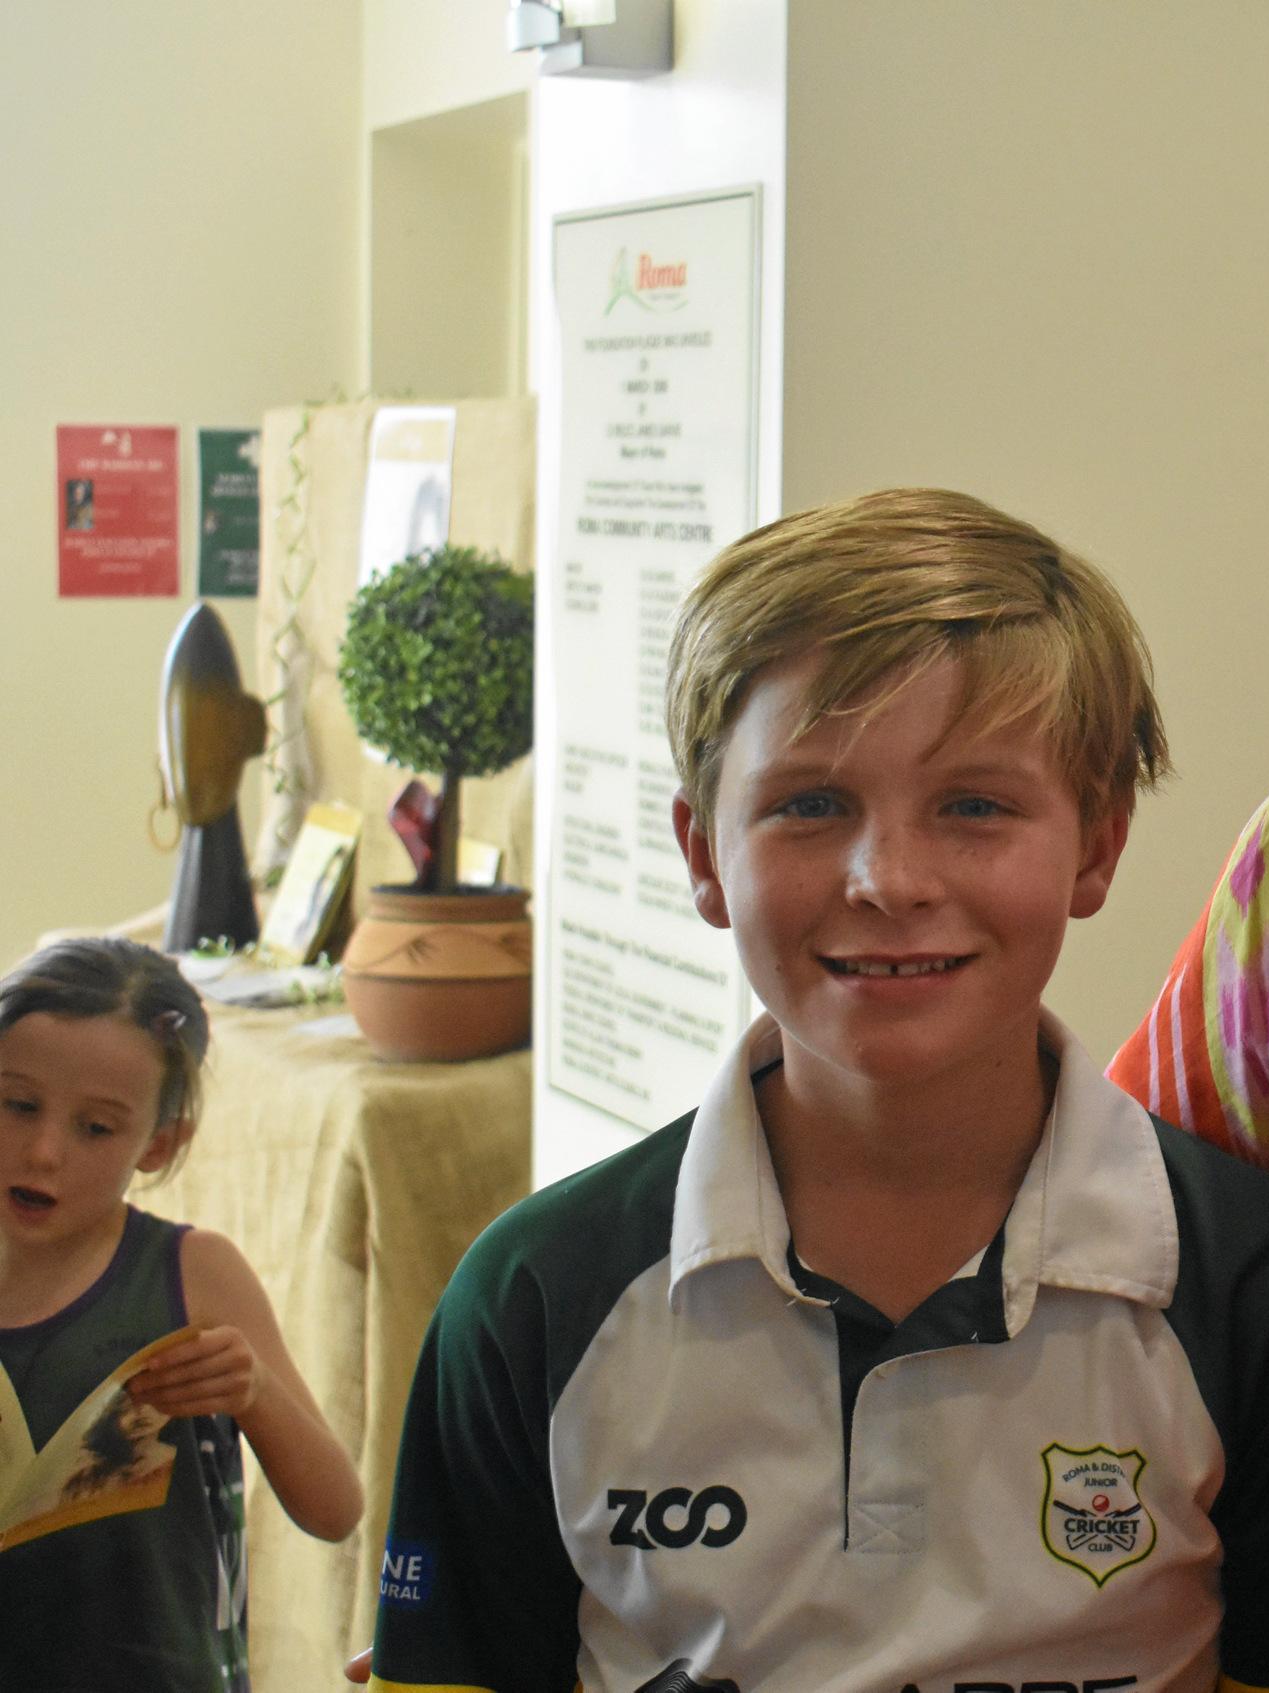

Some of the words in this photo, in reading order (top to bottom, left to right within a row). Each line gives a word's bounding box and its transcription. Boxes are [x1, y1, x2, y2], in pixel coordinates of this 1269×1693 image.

[637, 254, 687, 290] Roma
[1062, 1463, 1090, 1482] ROMA
[1084, 1477, 1118, 1488] JUNIOR
[1064, 1517, 1140, 1535] CRICKET
[1088, 1542, 1113, 1553] CLUB
